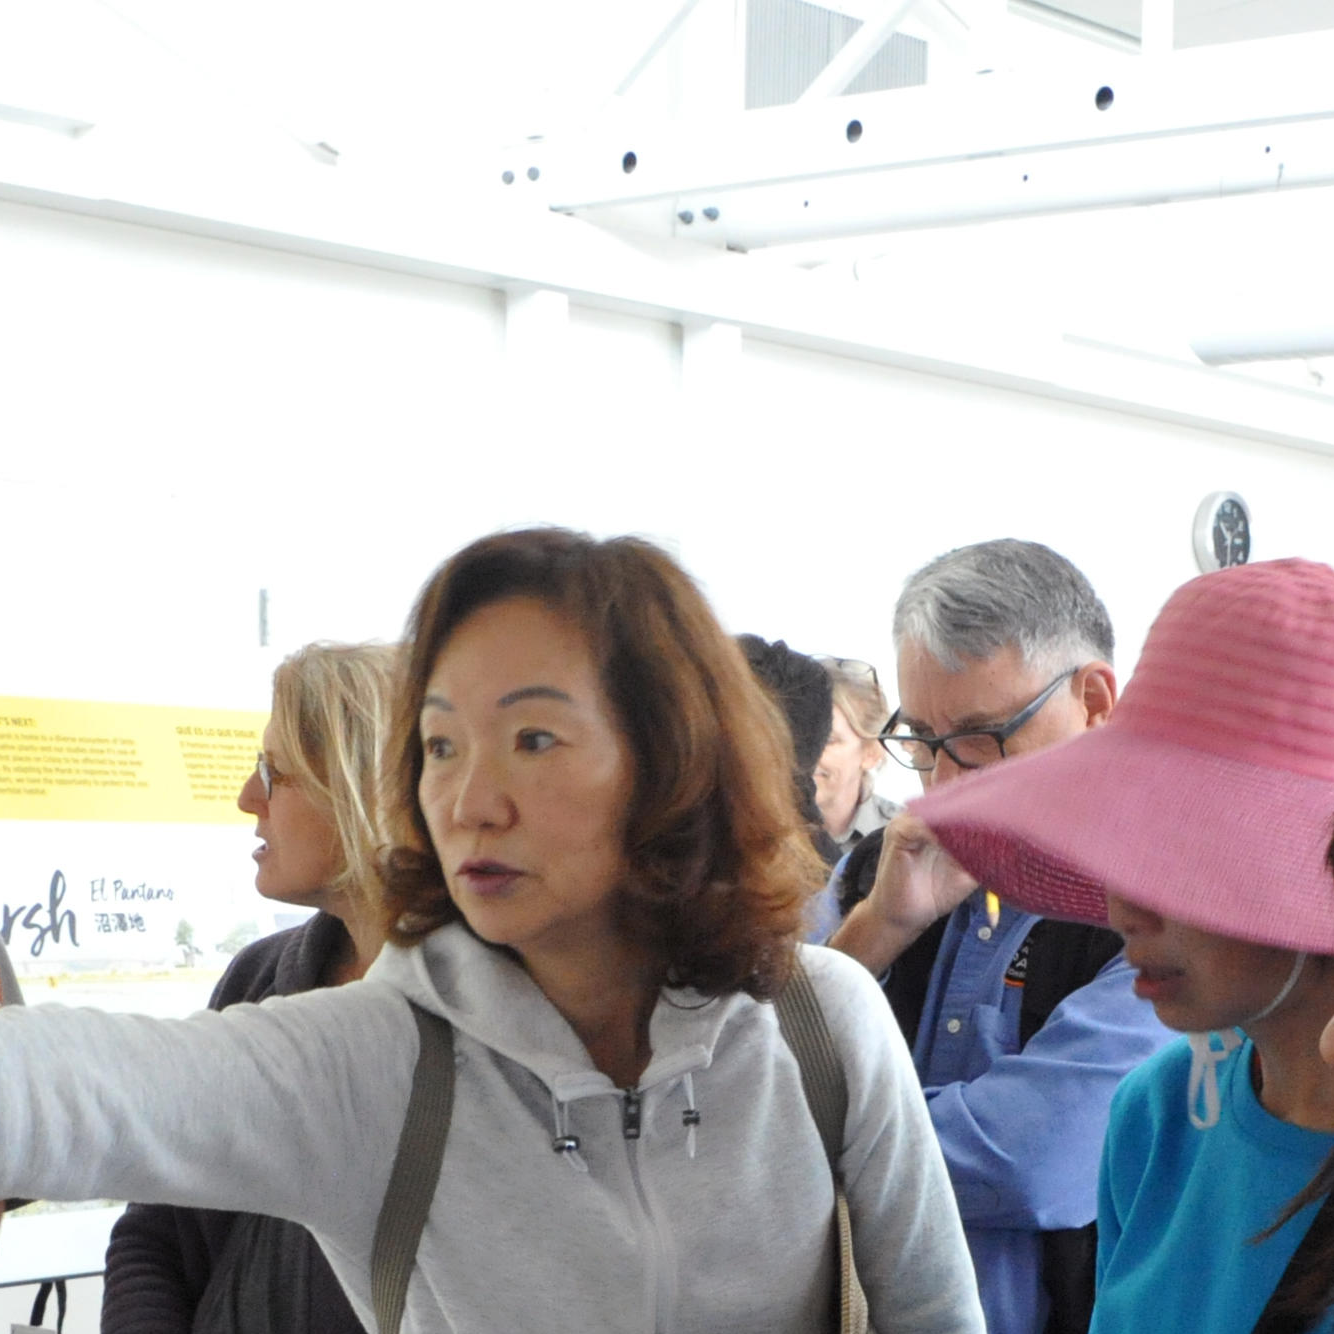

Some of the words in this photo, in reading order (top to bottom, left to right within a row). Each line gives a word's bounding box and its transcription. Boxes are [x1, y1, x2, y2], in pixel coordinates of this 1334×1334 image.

[1, 869, 80, 957] rsh
[90, 877, 108, 902] El
[113, 879, 174, 902] Pantano
